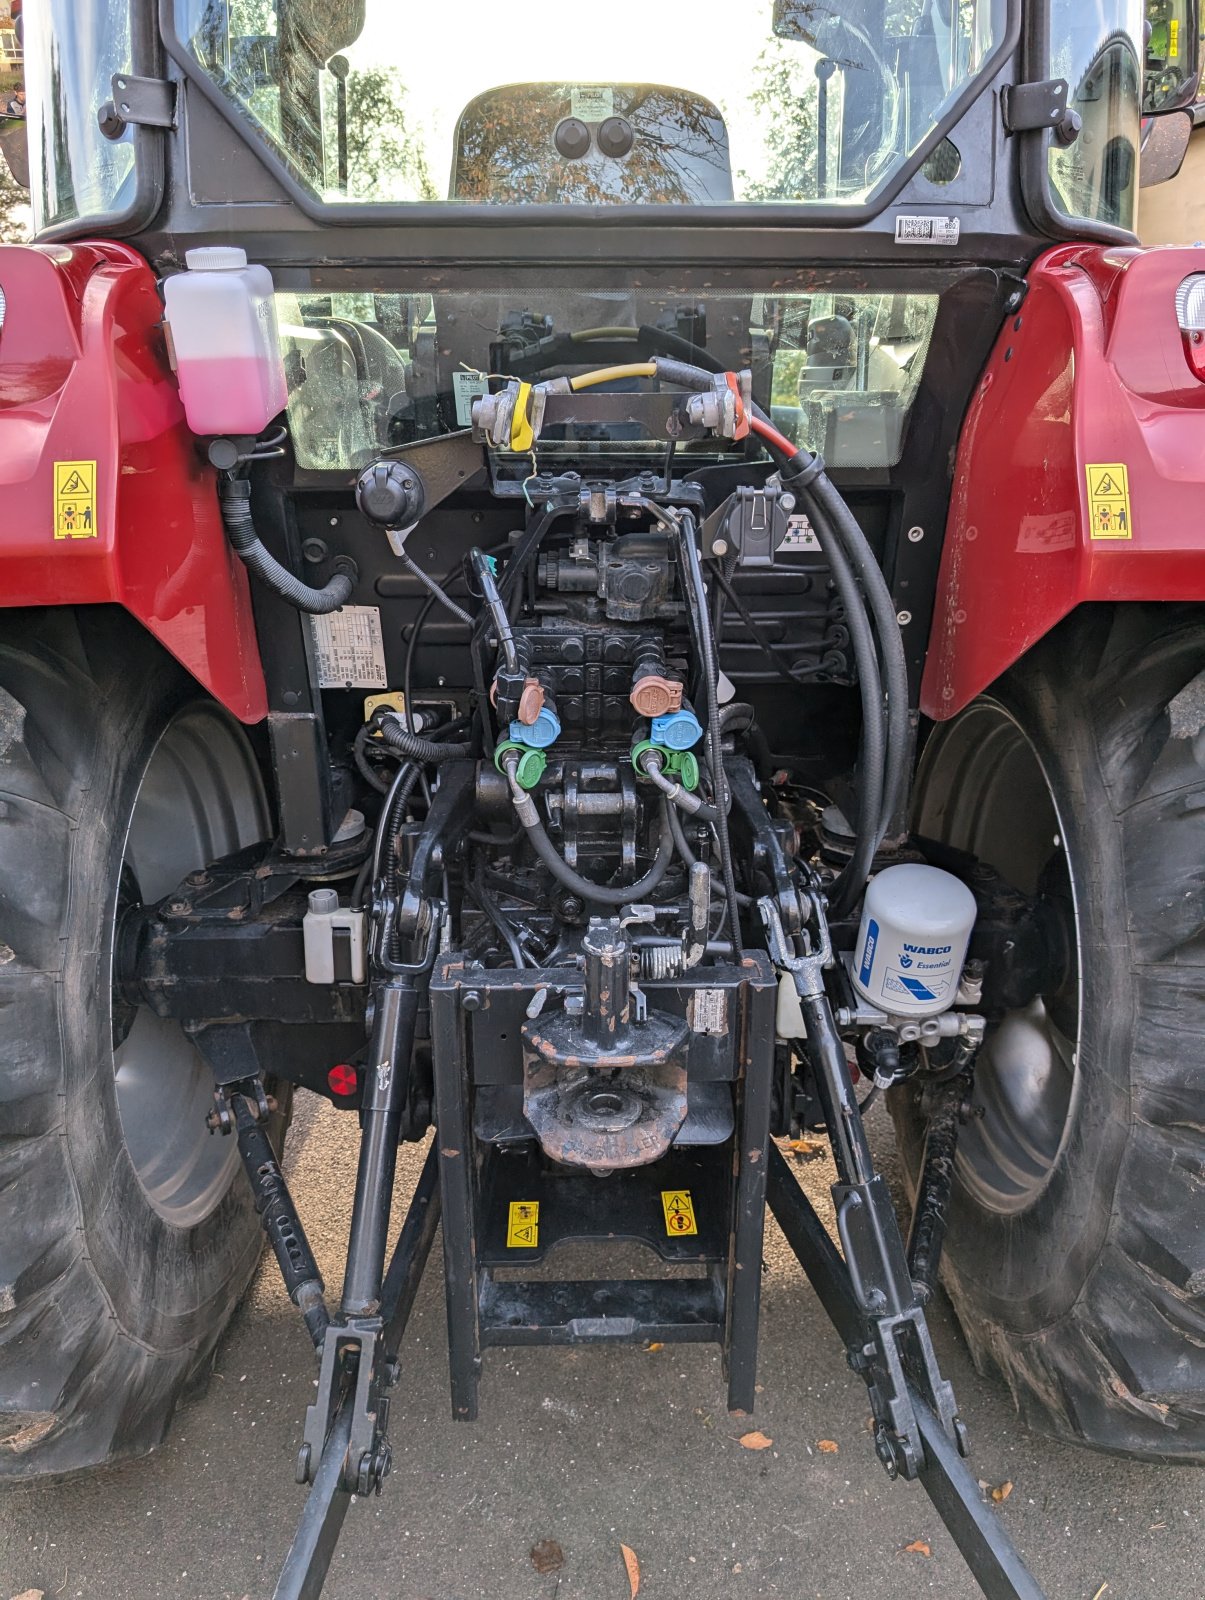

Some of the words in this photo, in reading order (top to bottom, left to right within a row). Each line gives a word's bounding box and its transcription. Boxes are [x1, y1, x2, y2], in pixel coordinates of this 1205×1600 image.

[863, 936, 875, 970] WABCO
[903, 943, 951, 954] WABCO
[916, 958, 951, 969] Essential
